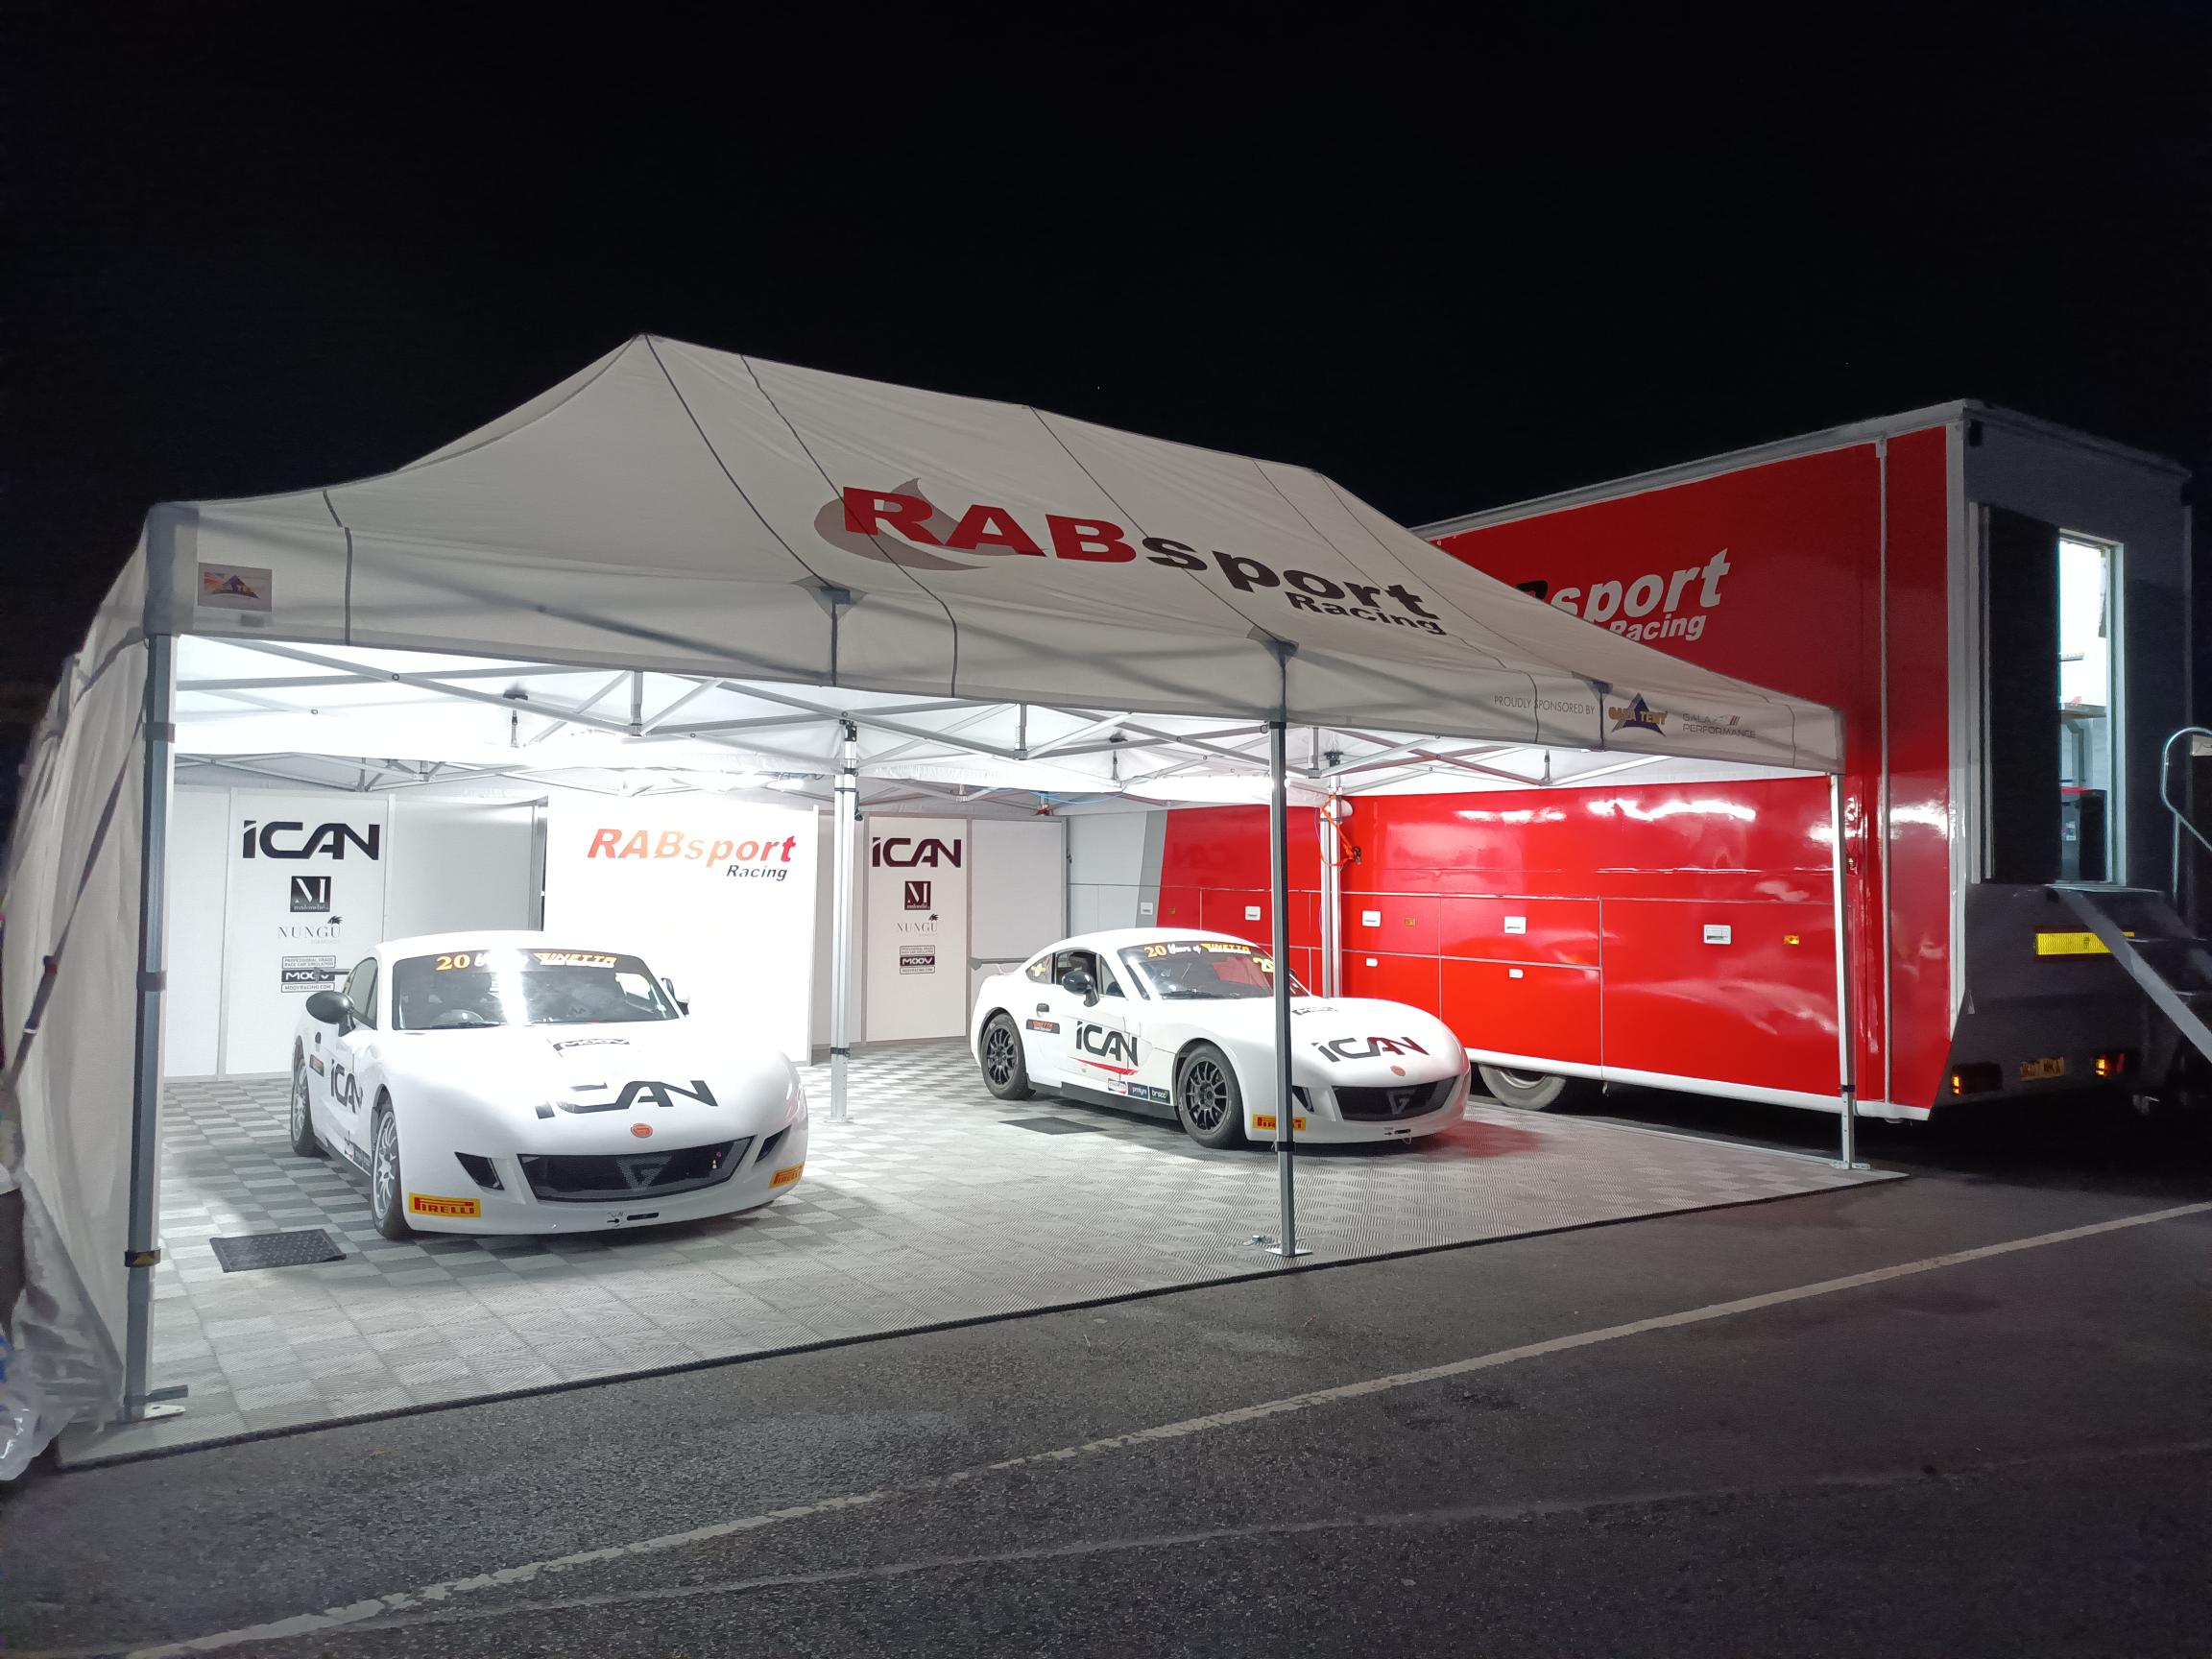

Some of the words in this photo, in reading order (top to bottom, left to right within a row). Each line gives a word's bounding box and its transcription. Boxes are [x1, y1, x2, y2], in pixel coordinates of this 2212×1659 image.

[843, 486, 1442, 620] RABsport
[1284, 590, 1447, 636] Racing
[1494, 695, 1532, 709] PROUDLY
[1534, 699, 1584, 714] SPONSORED
[1585, 704, 1596, 715] BY
[1682, 712, 1712, 724] GALA
[1682, 723, 1756, 738] PERFORMANCE
[587, 829, 797, 868] RABsport
[726, 864, 788, 882] Racing
[277, 926, 342, 939] NUNGU
[897, 922, 938, 932] NUNGU
[1143, 945, 1168, 958] 20
[436, 954, 470, 972] 20
[414, 1197, 475, 1214] PIRELLI
